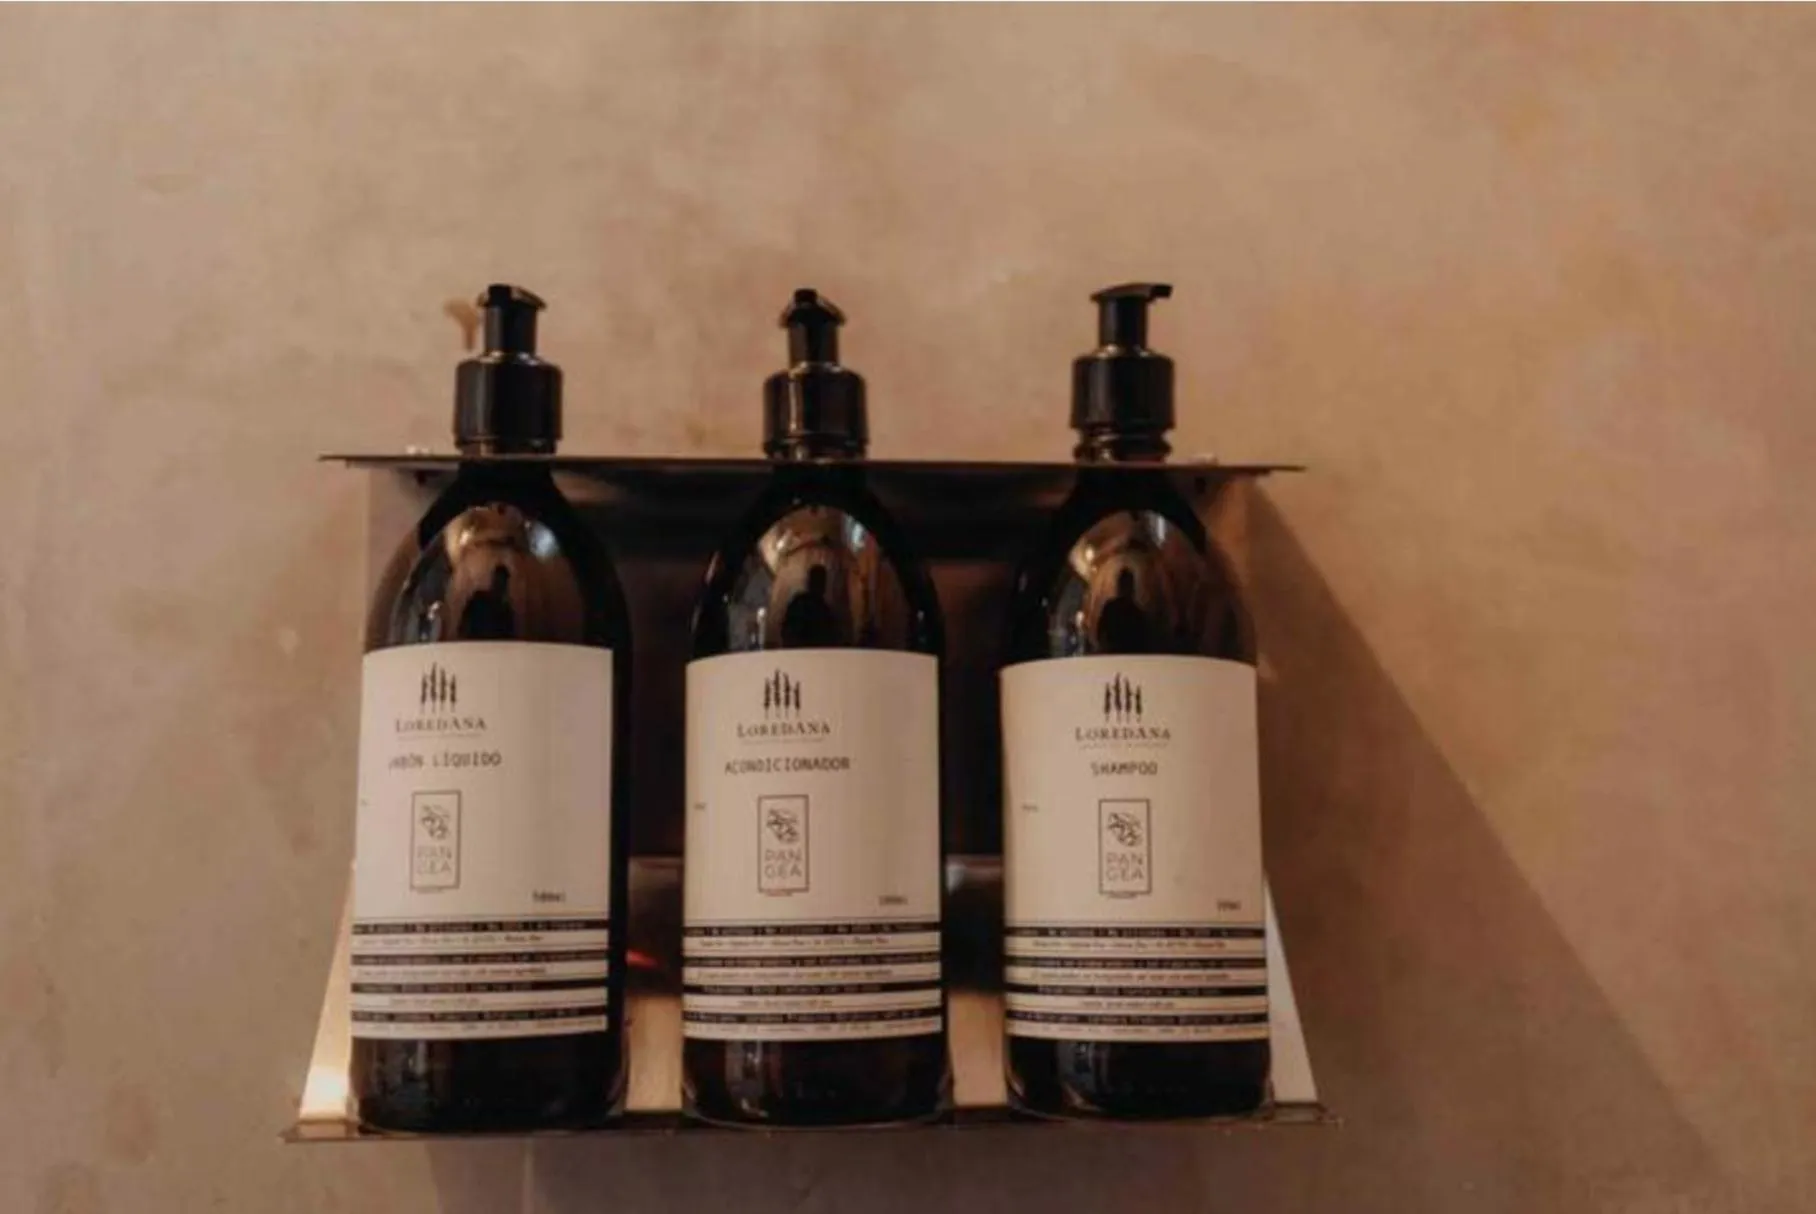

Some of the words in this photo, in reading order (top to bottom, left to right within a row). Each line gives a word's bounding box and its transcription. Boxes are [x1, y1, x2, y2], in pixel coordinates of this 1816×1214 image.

[737, 721, 831, 738] LOREDANA
[1075, 726, 1172, 742] LOREDANA
[724, 756, 851, 774] ACONDICIONADOR
[1090, 760, 1158, 777] SHAMPOO
[764, 848, 803, 862] PAN
[1106, 852, 1144, 866] PAN
